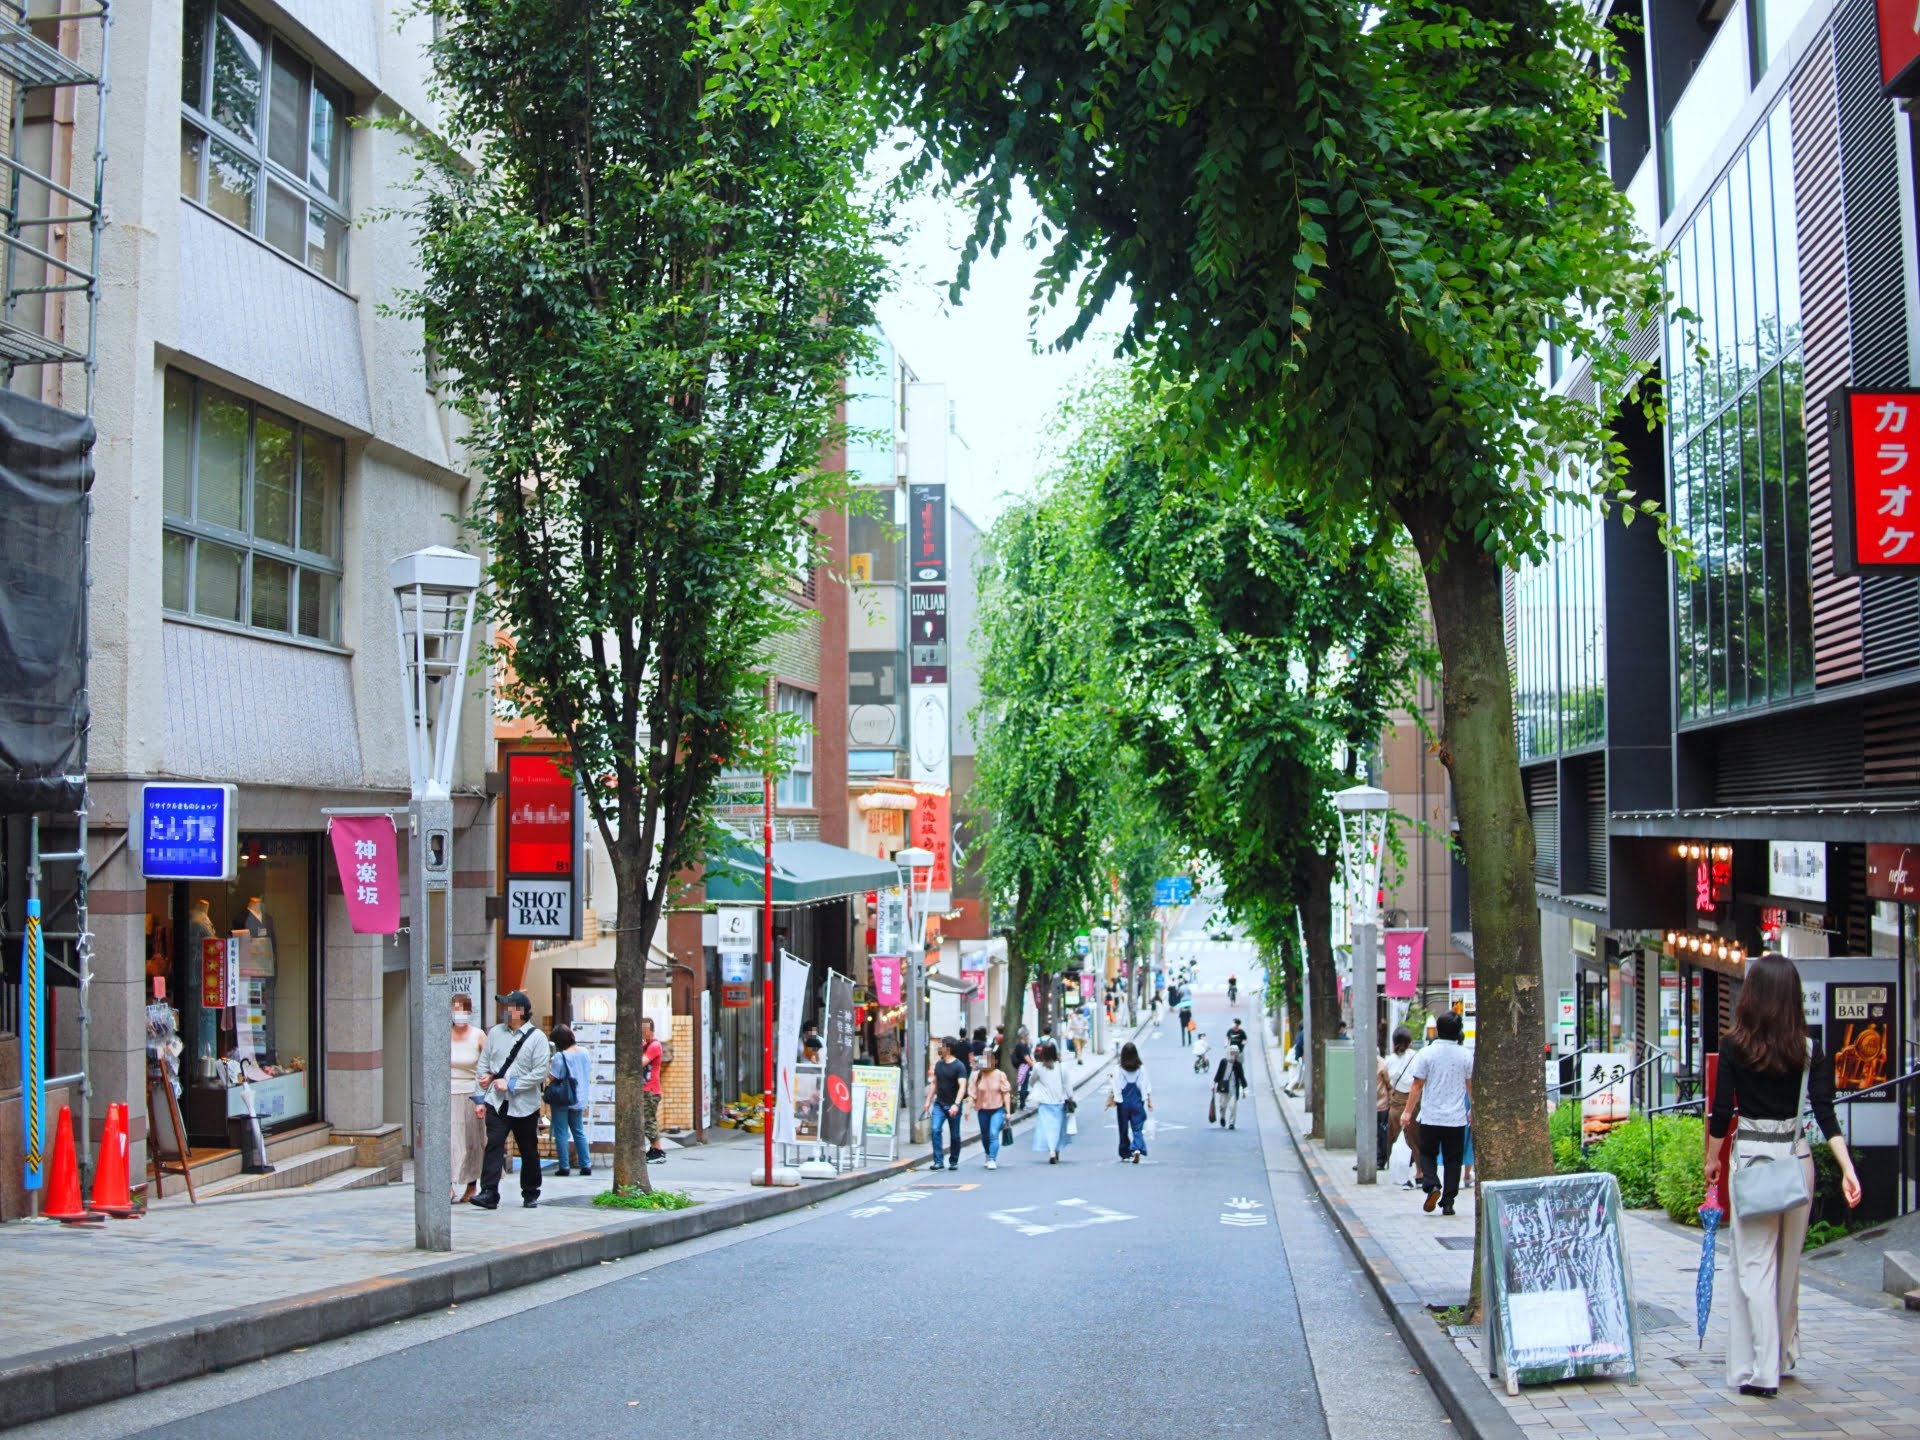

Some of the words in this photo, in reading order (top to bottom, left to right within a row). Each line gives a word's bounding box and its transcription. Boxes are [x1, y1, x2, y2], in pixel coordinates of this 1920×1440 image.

[1874, 401, 1915, 559] カラオケ
[911, 593, 945, 611] ITALIAN
[149, 802, 219, 811] リサイクルきものショップ
[354, 839, 380, 905] 神楽坂
[556, 861, 570, 871] B1
[512, 891, 567, 909] SHOT
[519, 909, 560, 926] BAR
[1397, 944, 1412, 982] 神楽坂
[1838, 1005, 1866, 1017] BAR
[1588, 1063, 1626, 1084] 寿司
